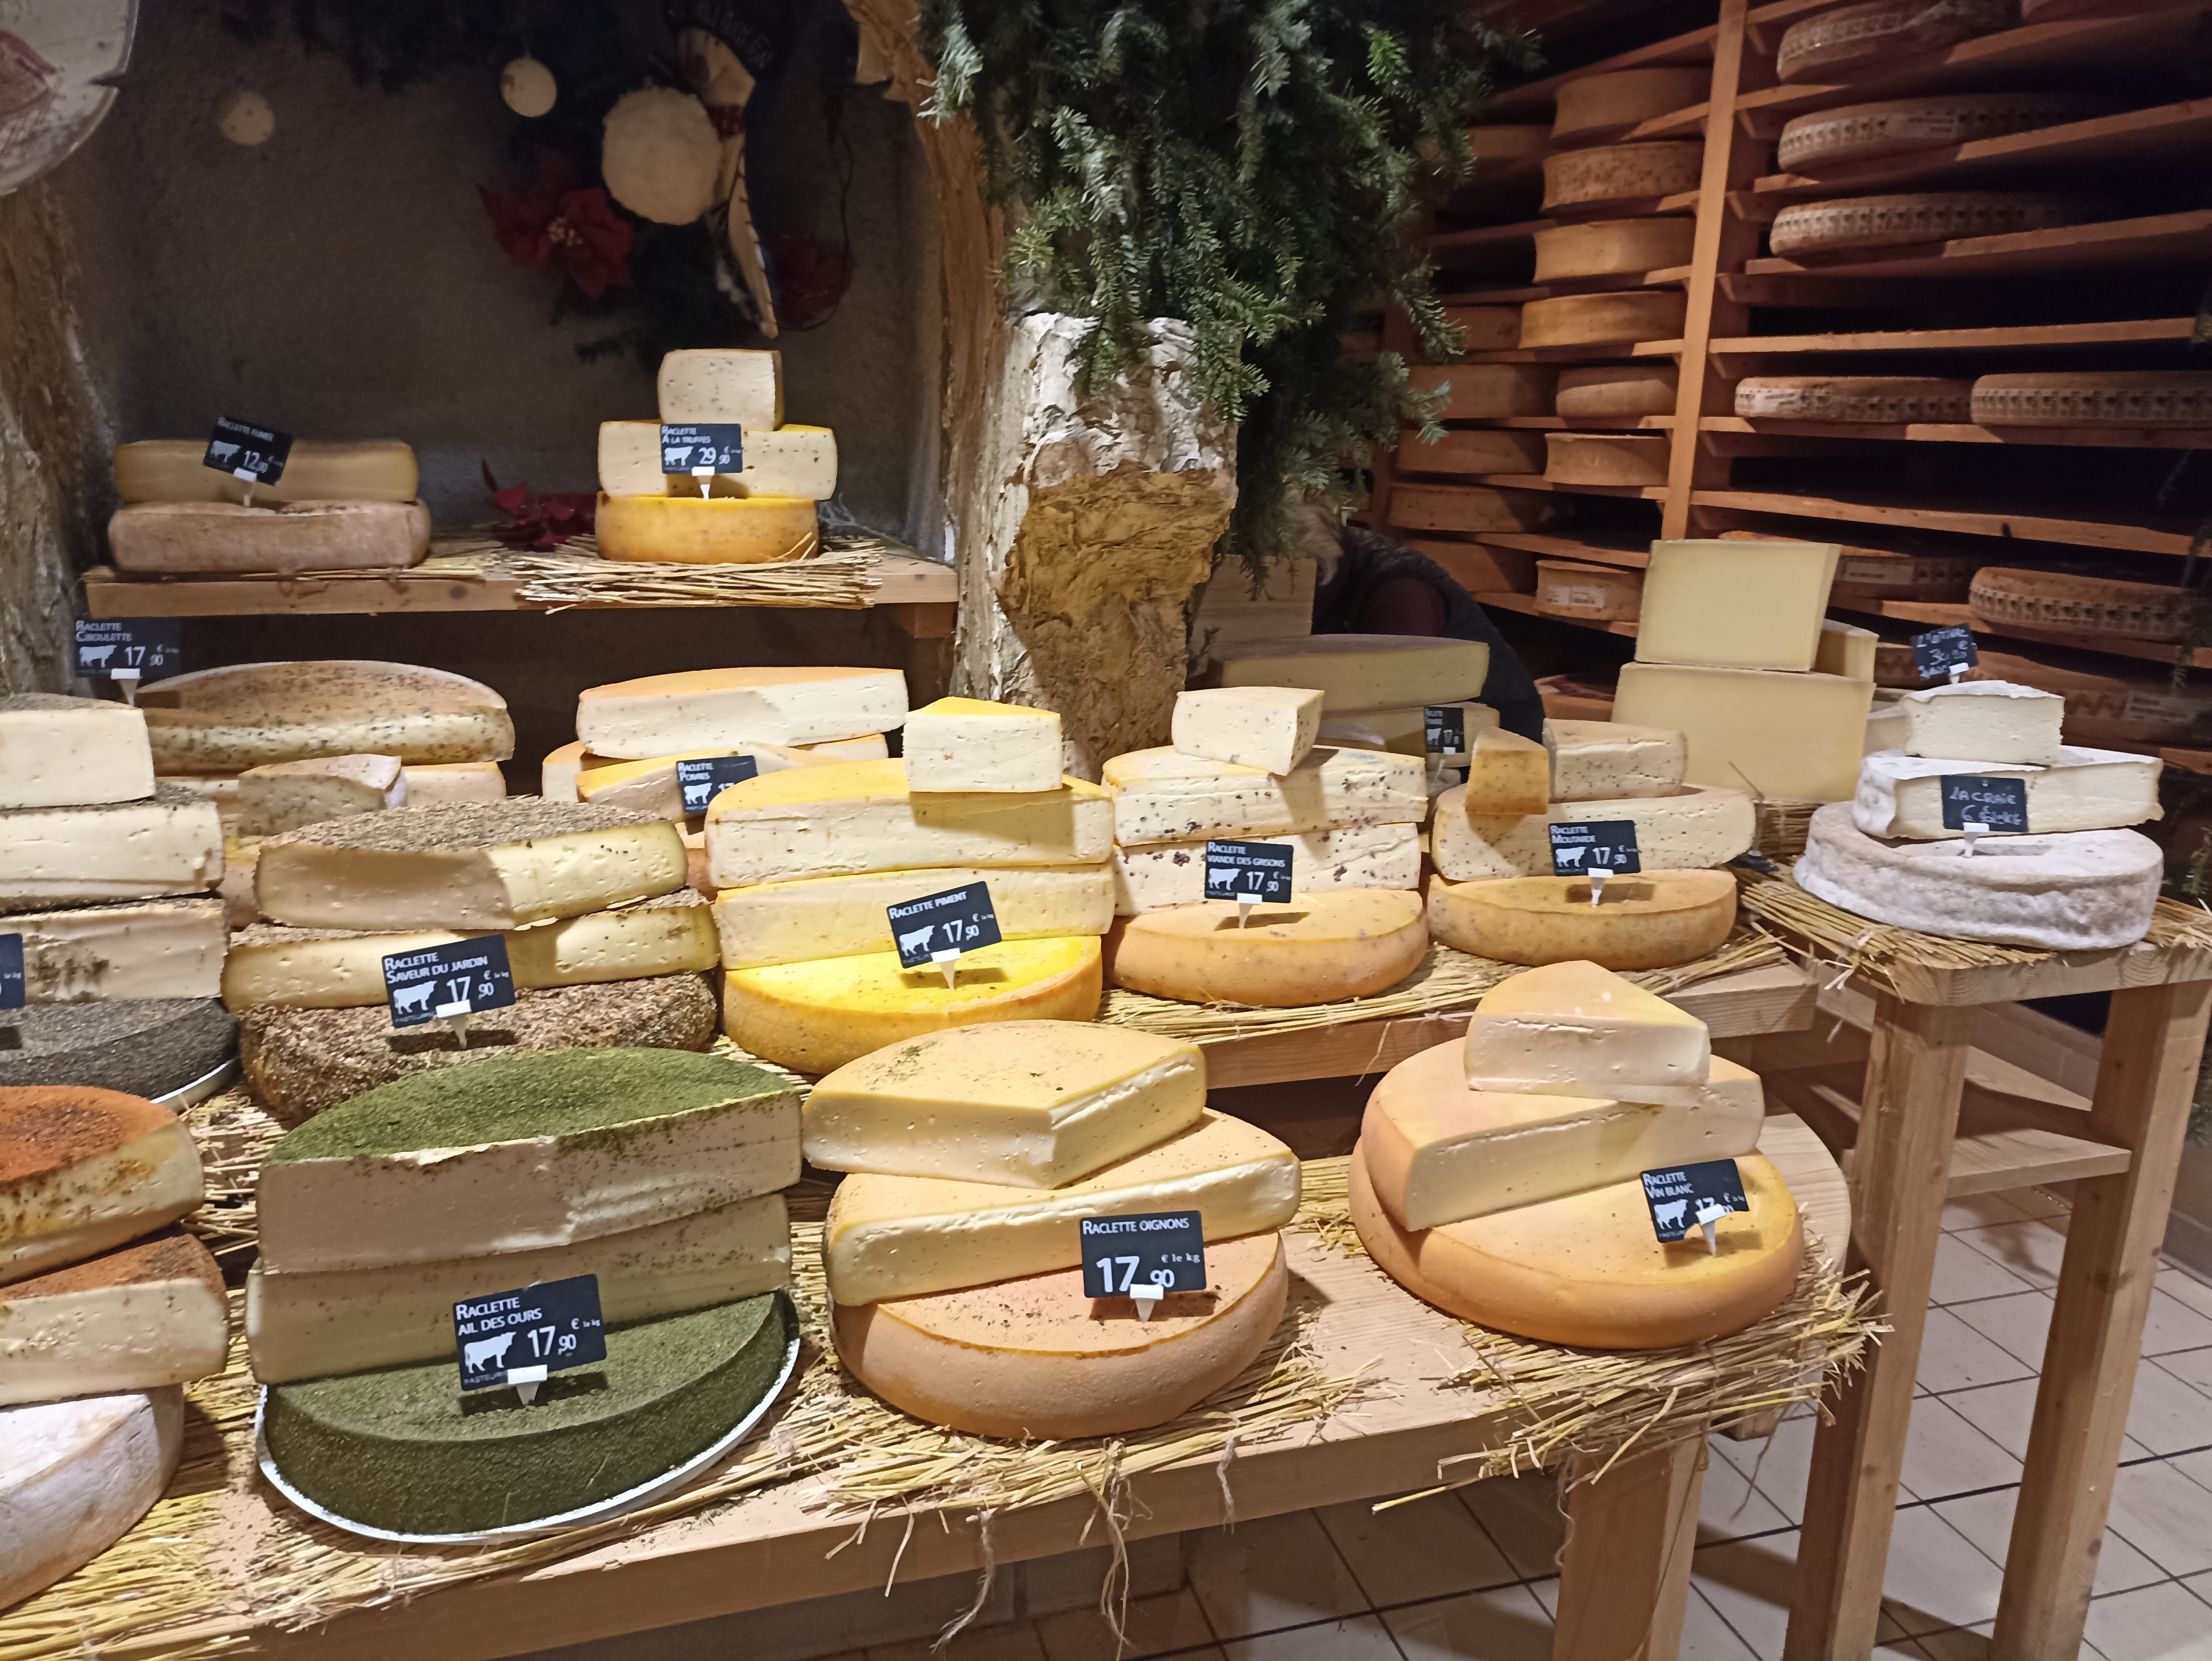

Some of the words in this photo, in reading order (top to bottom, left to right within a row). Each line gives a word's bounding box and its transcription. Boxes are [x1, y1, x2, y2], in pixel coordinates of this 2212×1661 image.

[698, 447, 717, 465] 29
[124, 646, 145, 666] 17
[1207, 842, 1247, 854] RACLETTE
[1592, 847, 1611, 864] 17
[1246, 871, 1265, 890] 17
[888, 900, 936, 919] RACLETTE
[934, 891, 967, 907] PIMENT
[942, 919, 963, 943] 17
[384, 952, 439, 971] RACLETTE
[386, 967, 431, 984] SAVEUR
[431, 963, 449, 975] DU
[451, 955, 488, 972] JARDIN
[446, 975, 471, 1003] 17
[1642, 1171, 1687, 1186] RACLETTE
[1665, 1183, 1694, 1196] BLANC
[1082, 1220, 1138, 1235] RACLETTE
[1139, 1218, 1190, 1231] OIGNONS
[1095, 1255, 1140, 1293] 17
[455, 1296, 521, 1320] RACLETTE
[457, 1323, 479, 1336] AIL
[480, 1316, 506, 1331] DES
[507, 1307, 543, 1325] OURS
[527, 1325, 556, 1358] 17
